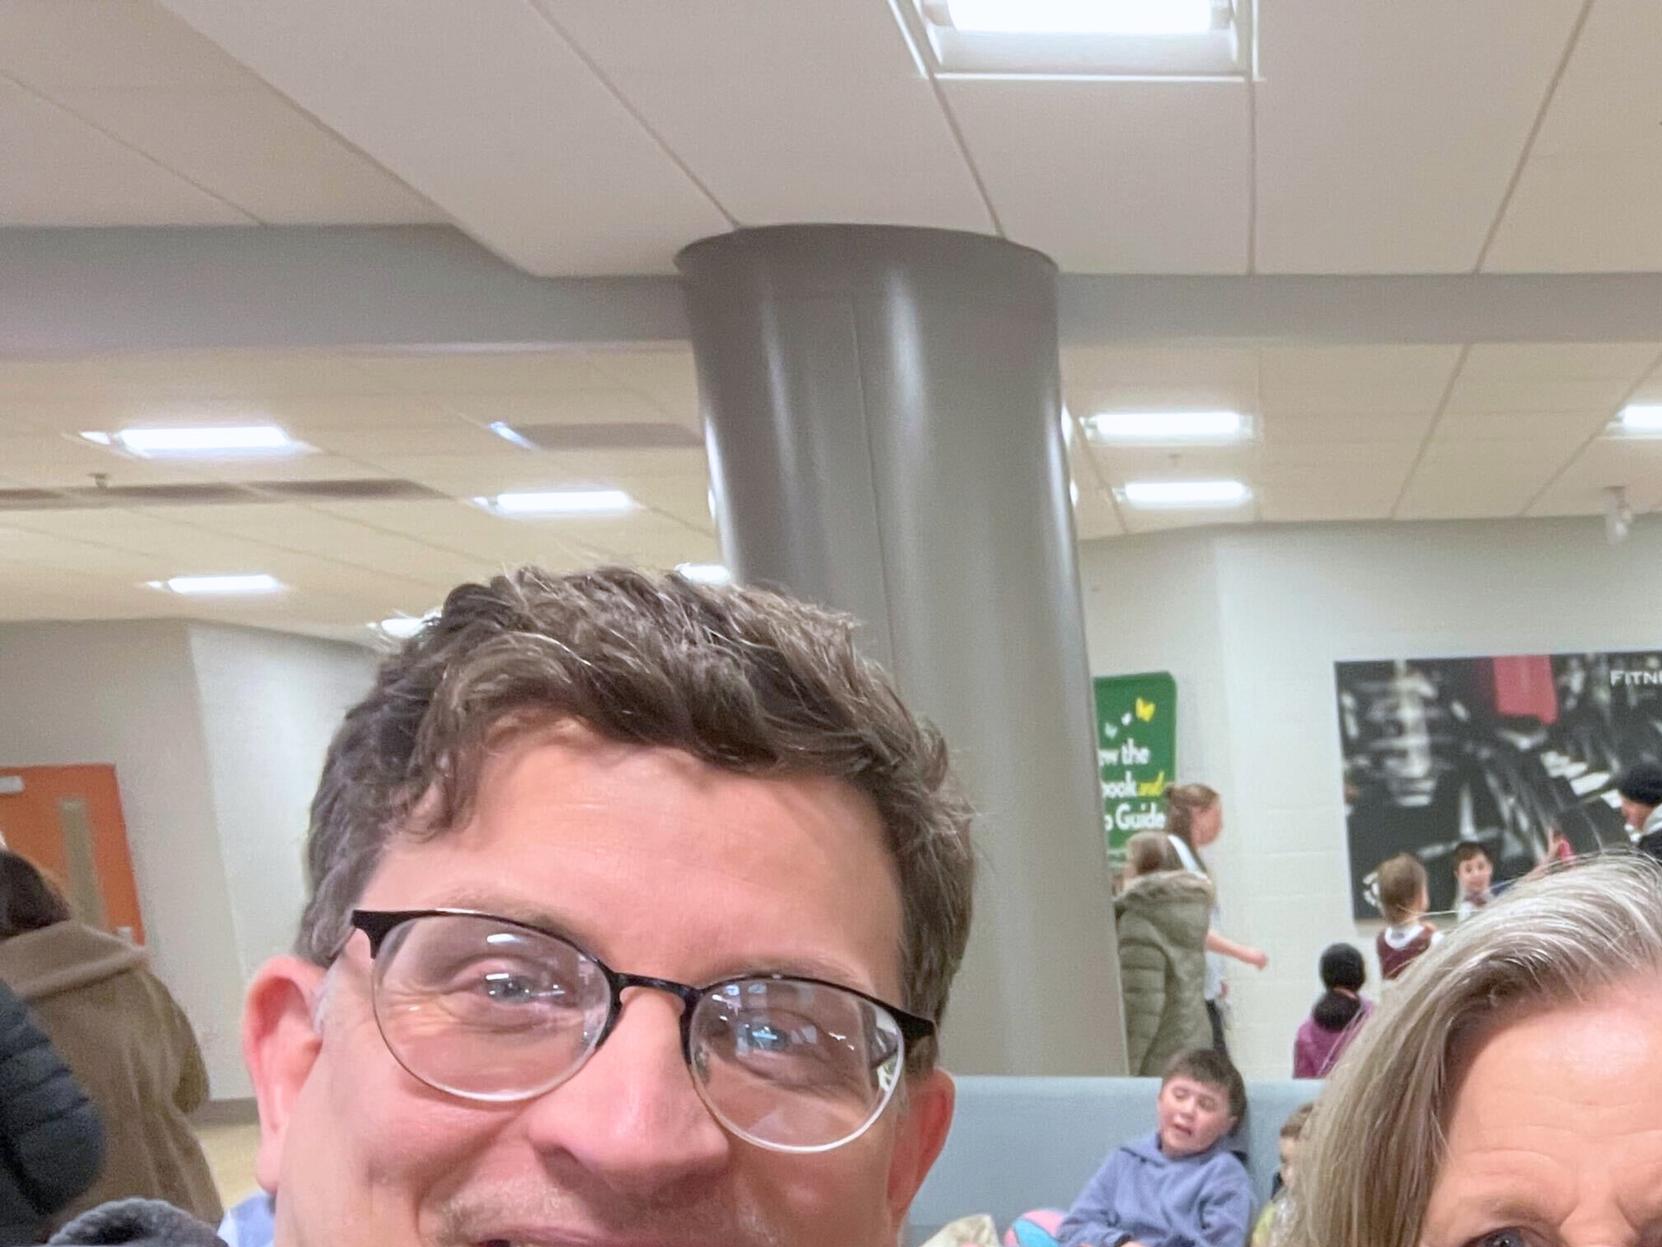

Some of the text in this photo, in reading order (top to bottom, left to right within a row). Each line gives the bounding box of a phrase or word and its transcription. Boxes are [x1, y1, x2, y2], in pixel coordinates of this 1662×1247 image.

[1121, 738, 1150, 766] the
[1102, 770, 1137, 798] ook
[1115, 801, 1167, 830] Guide
